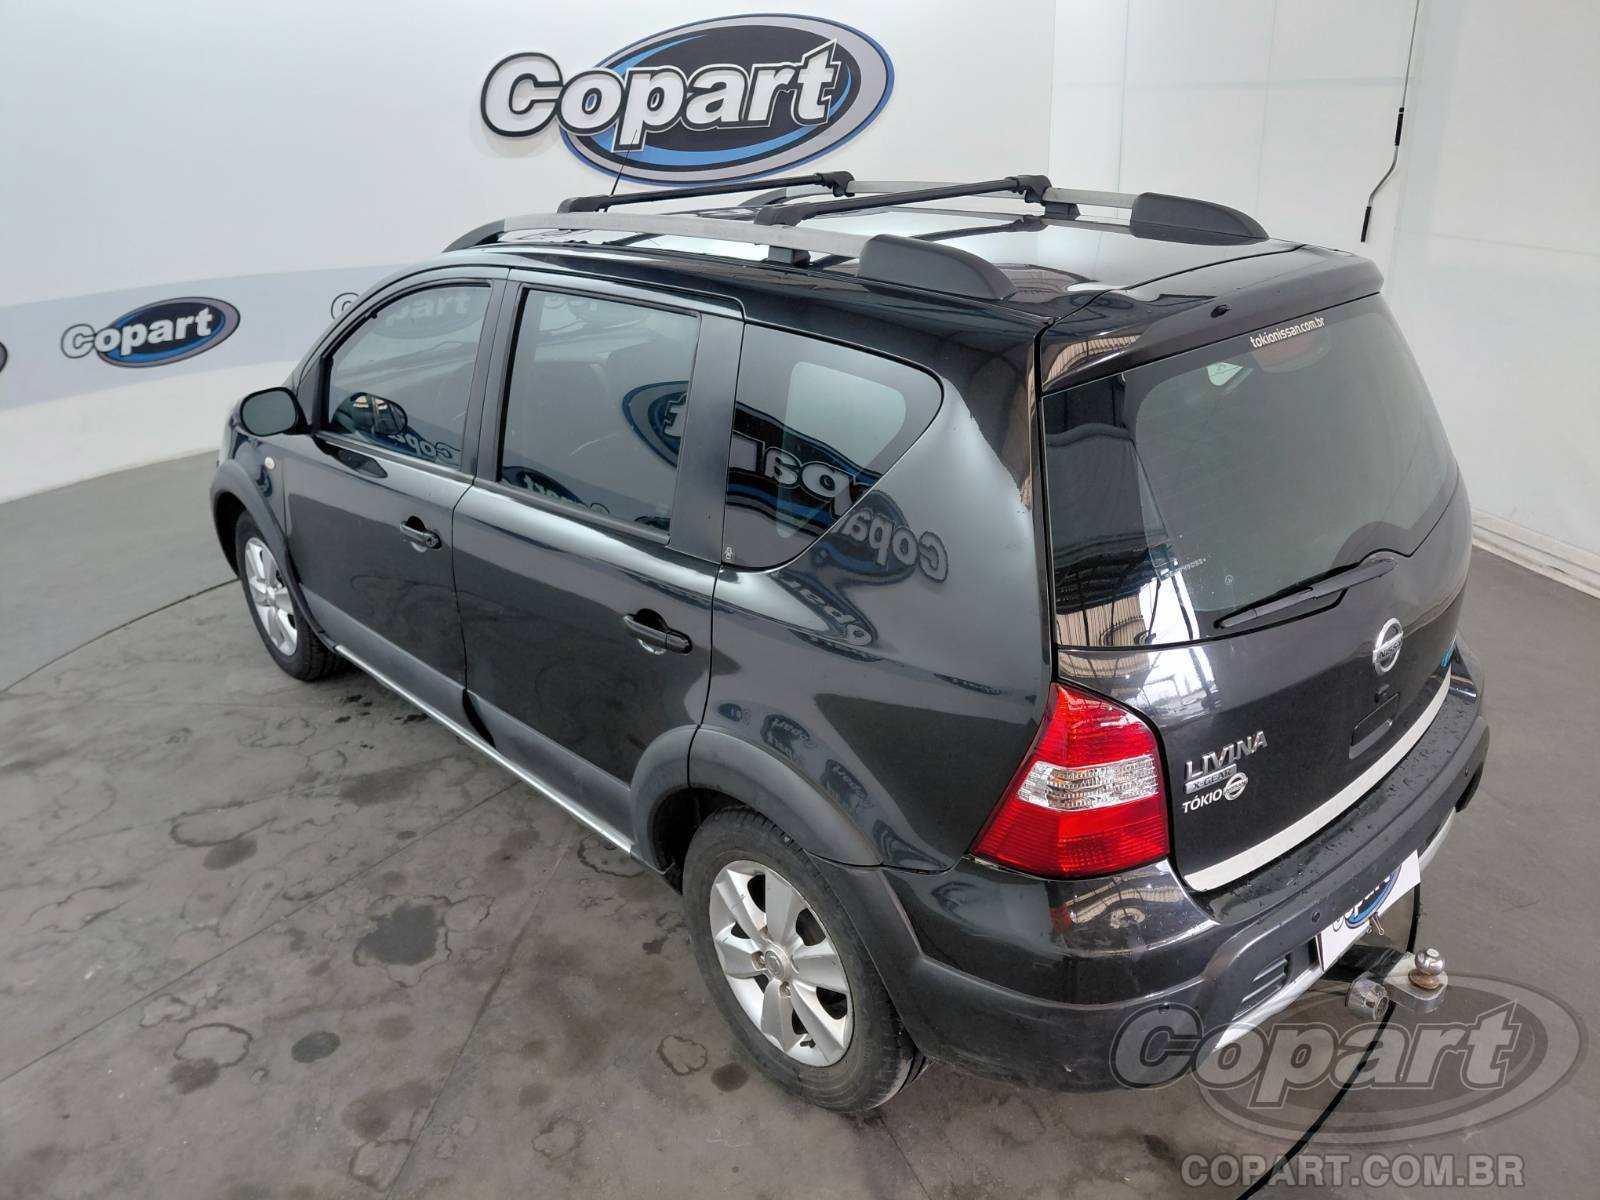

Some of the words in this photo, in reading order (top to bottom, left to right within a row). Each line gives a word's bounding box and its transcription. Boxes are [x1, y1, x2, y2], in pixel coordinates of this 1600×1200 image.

[481, 39, 841, 152] Copart
[61, 307, 213, 359] Copart
[1249, 316, 1325, 348] tokionissan.com.br
[1184, 730, 1268, 780] LIVINA
[1192, 769, 1233, 791] X-GEAR
